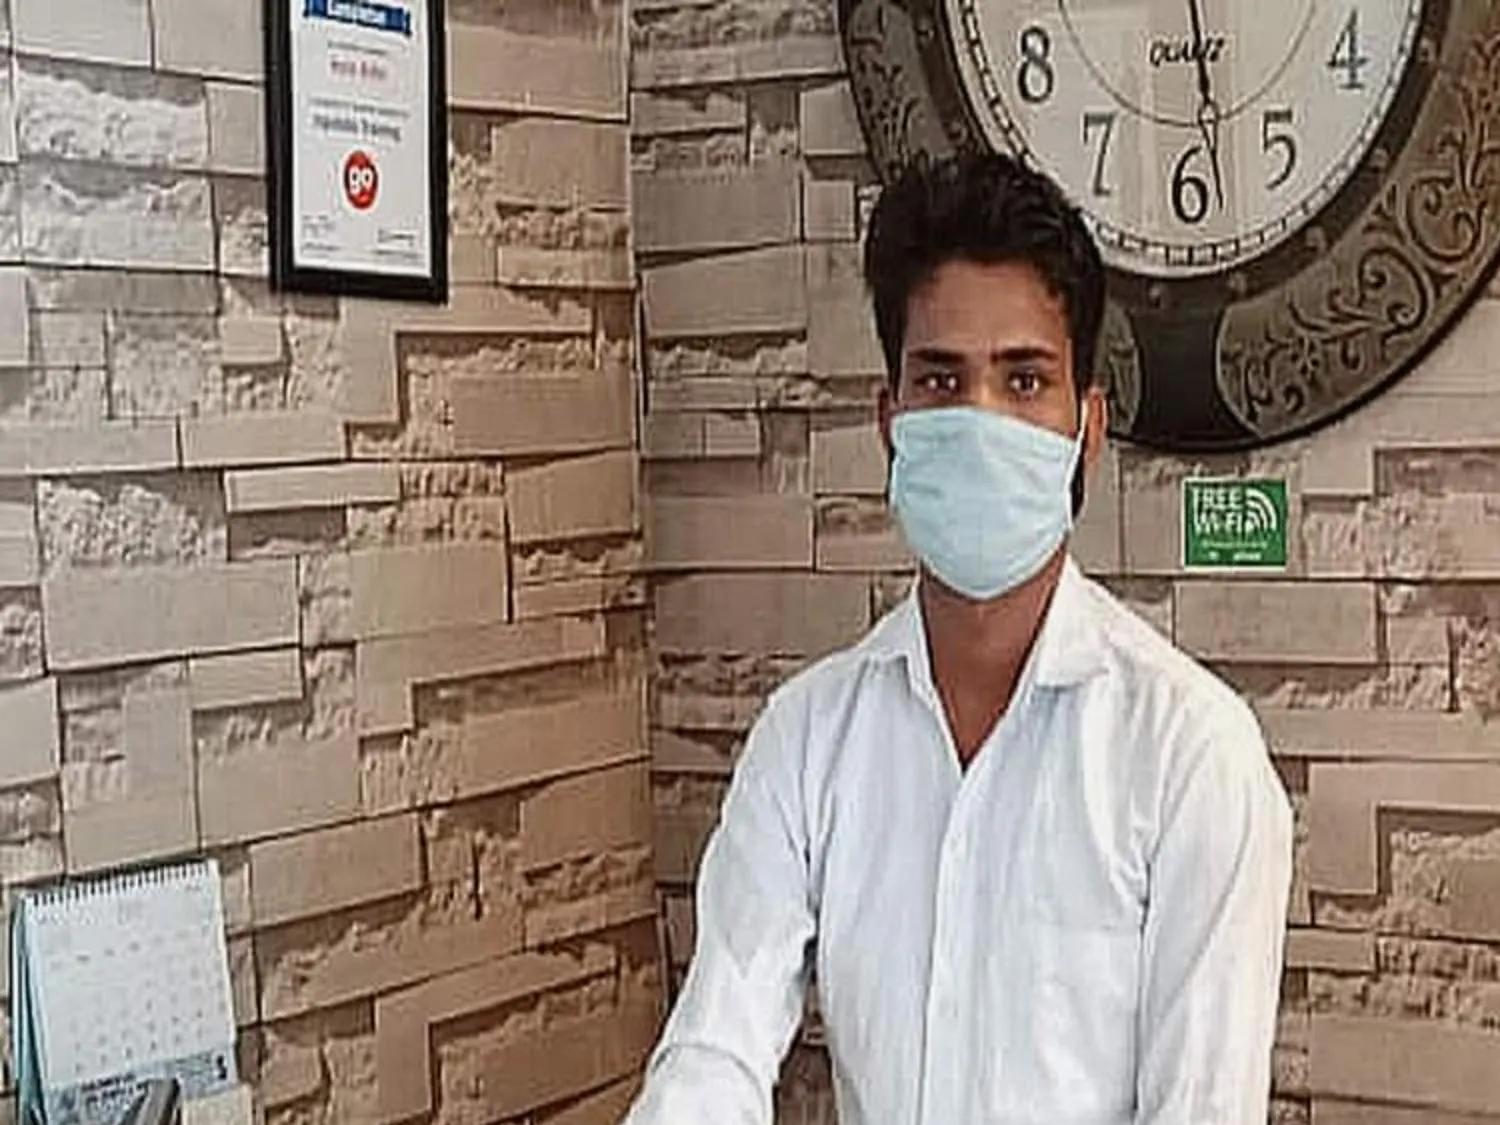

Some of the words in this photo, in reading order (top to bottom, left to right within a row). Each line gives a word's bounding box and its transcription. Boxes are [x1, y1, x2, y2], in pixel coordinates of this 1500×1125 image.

[1018, 26, 1054, 104] 8
[1327, 9, 1369, 90] 4
[1082, 111, 1119, 196] 7
[1171, 145, 1209, 224] 6
[1261, 109, 1298, 191] 5
